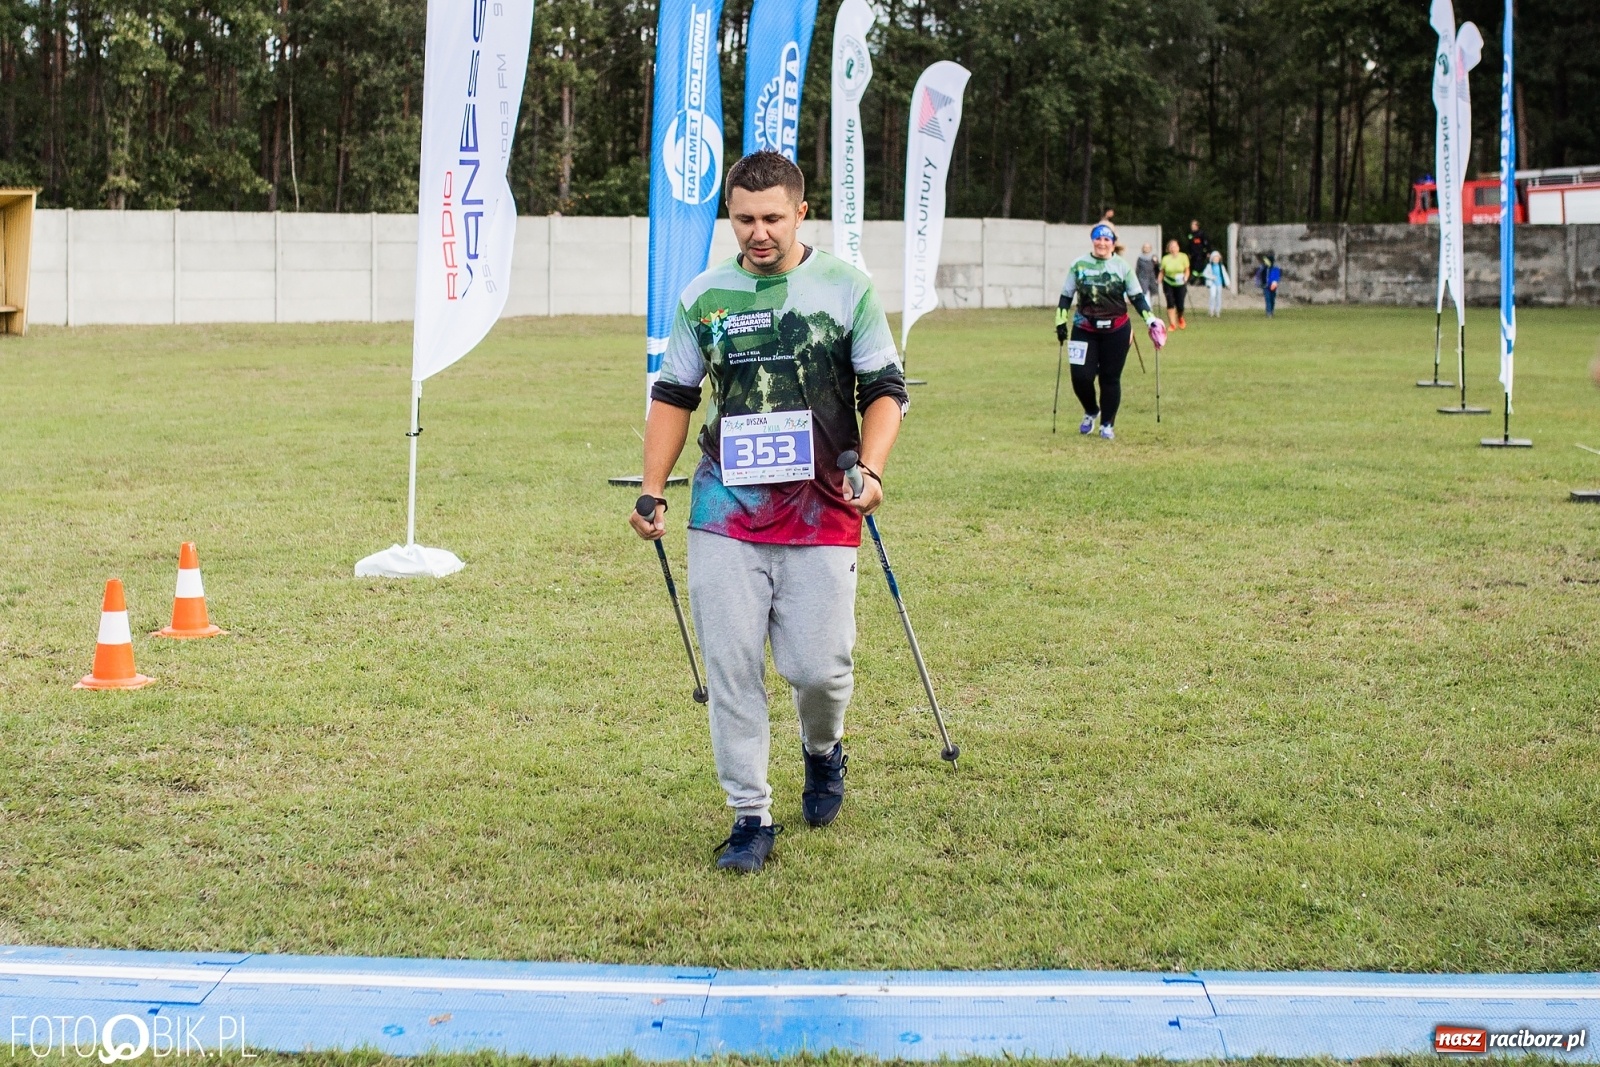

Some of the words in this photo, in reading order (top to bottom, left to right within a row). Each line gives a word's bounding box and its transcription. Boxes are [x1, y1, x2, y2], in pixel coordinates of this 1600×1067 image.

[496, 54, 508, 89] FM
[690, 13, 706, 108] ODLEWNIA
[688, 115, 699, 199] RAFAMET
[844, 118, 856, 225] Raciborskie
[442, 171, 457, 300] RADIO
[735, 435, 796, 468] 353
[746, 417, 768, 426] DYSZKA
